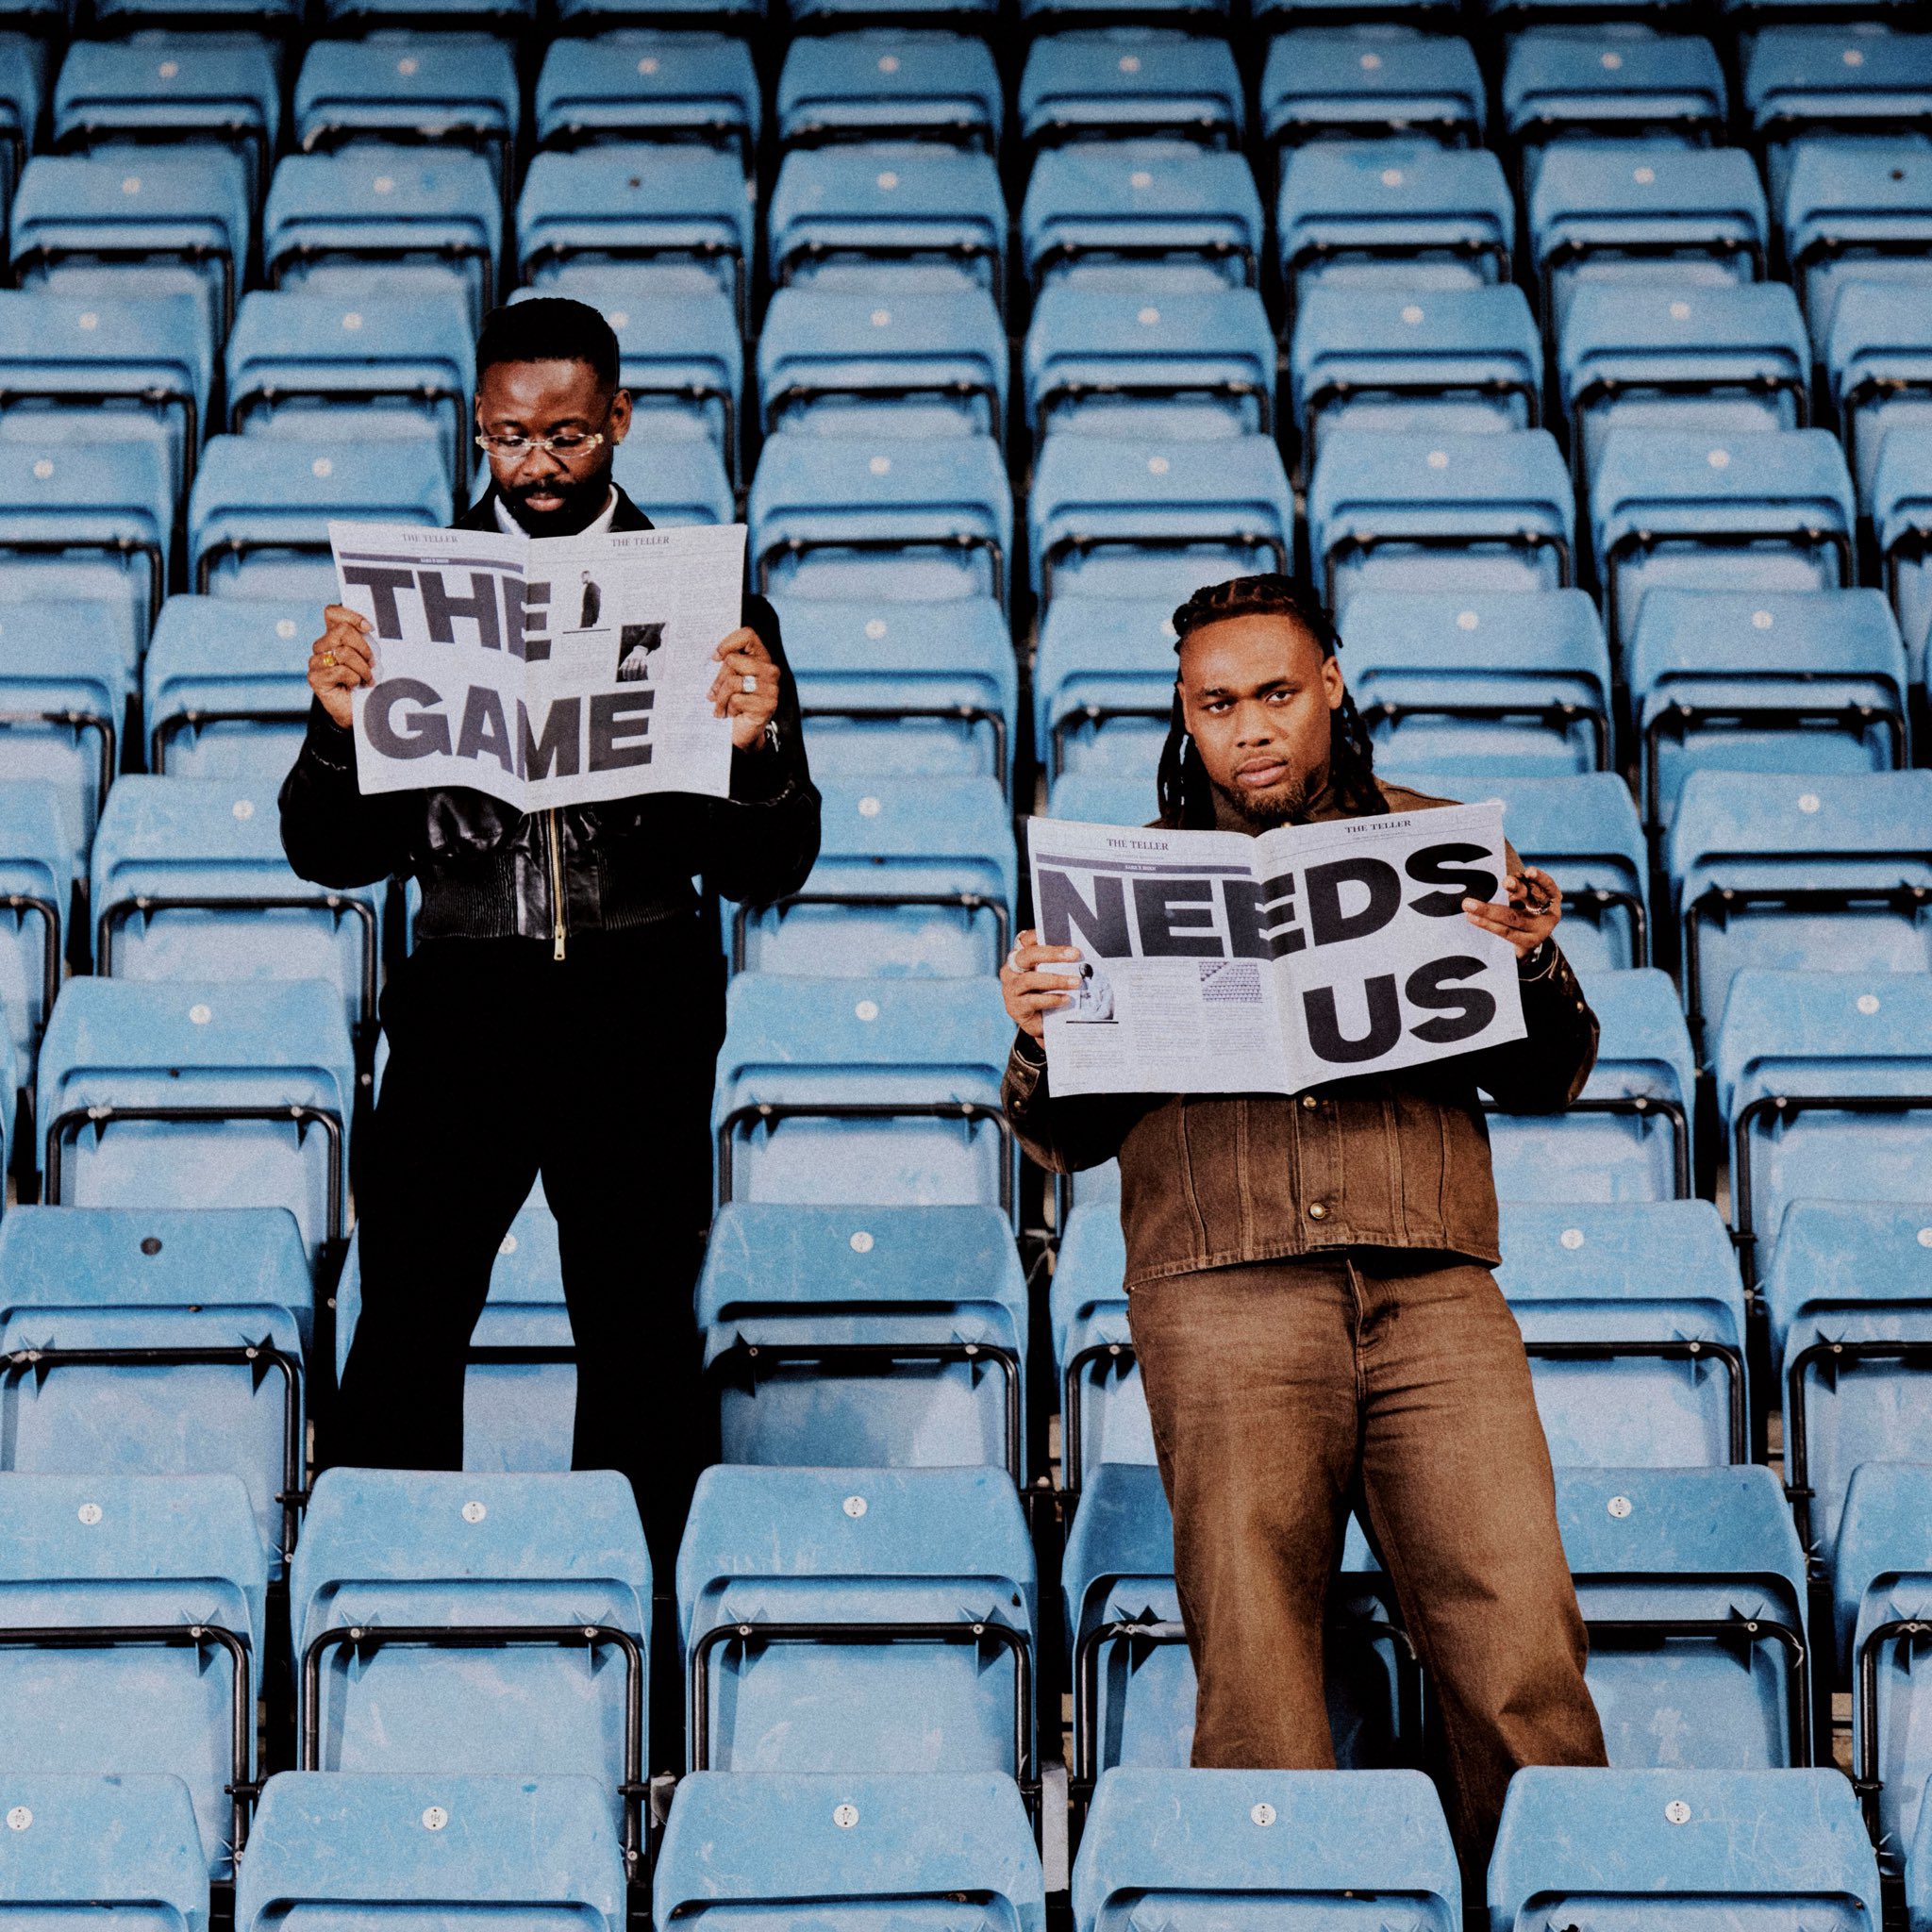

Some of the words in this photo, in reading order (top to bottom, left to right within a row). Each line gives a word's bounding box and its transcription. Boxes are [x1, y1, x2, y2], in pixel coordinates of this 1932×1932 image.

[402, 533, 419, 542] THE
[423, 534, 458, 543] TELLER
[610, 537, 631, 547] THE
[633, 535, 670, 546] TELLER
[341, 566, 552, 663] THE
[363, 677, 656, 783] GAME
[1107, 838, 1128, 849] THE
[1129, 840, 1169, 851] TELLER
[1344, 824, 1368, 834] THE
[1370, 820, 1412, 831] TELLER
[1038, 842, 1499, 962] NEEDS
[1302, 955, 1497, 1064] US
